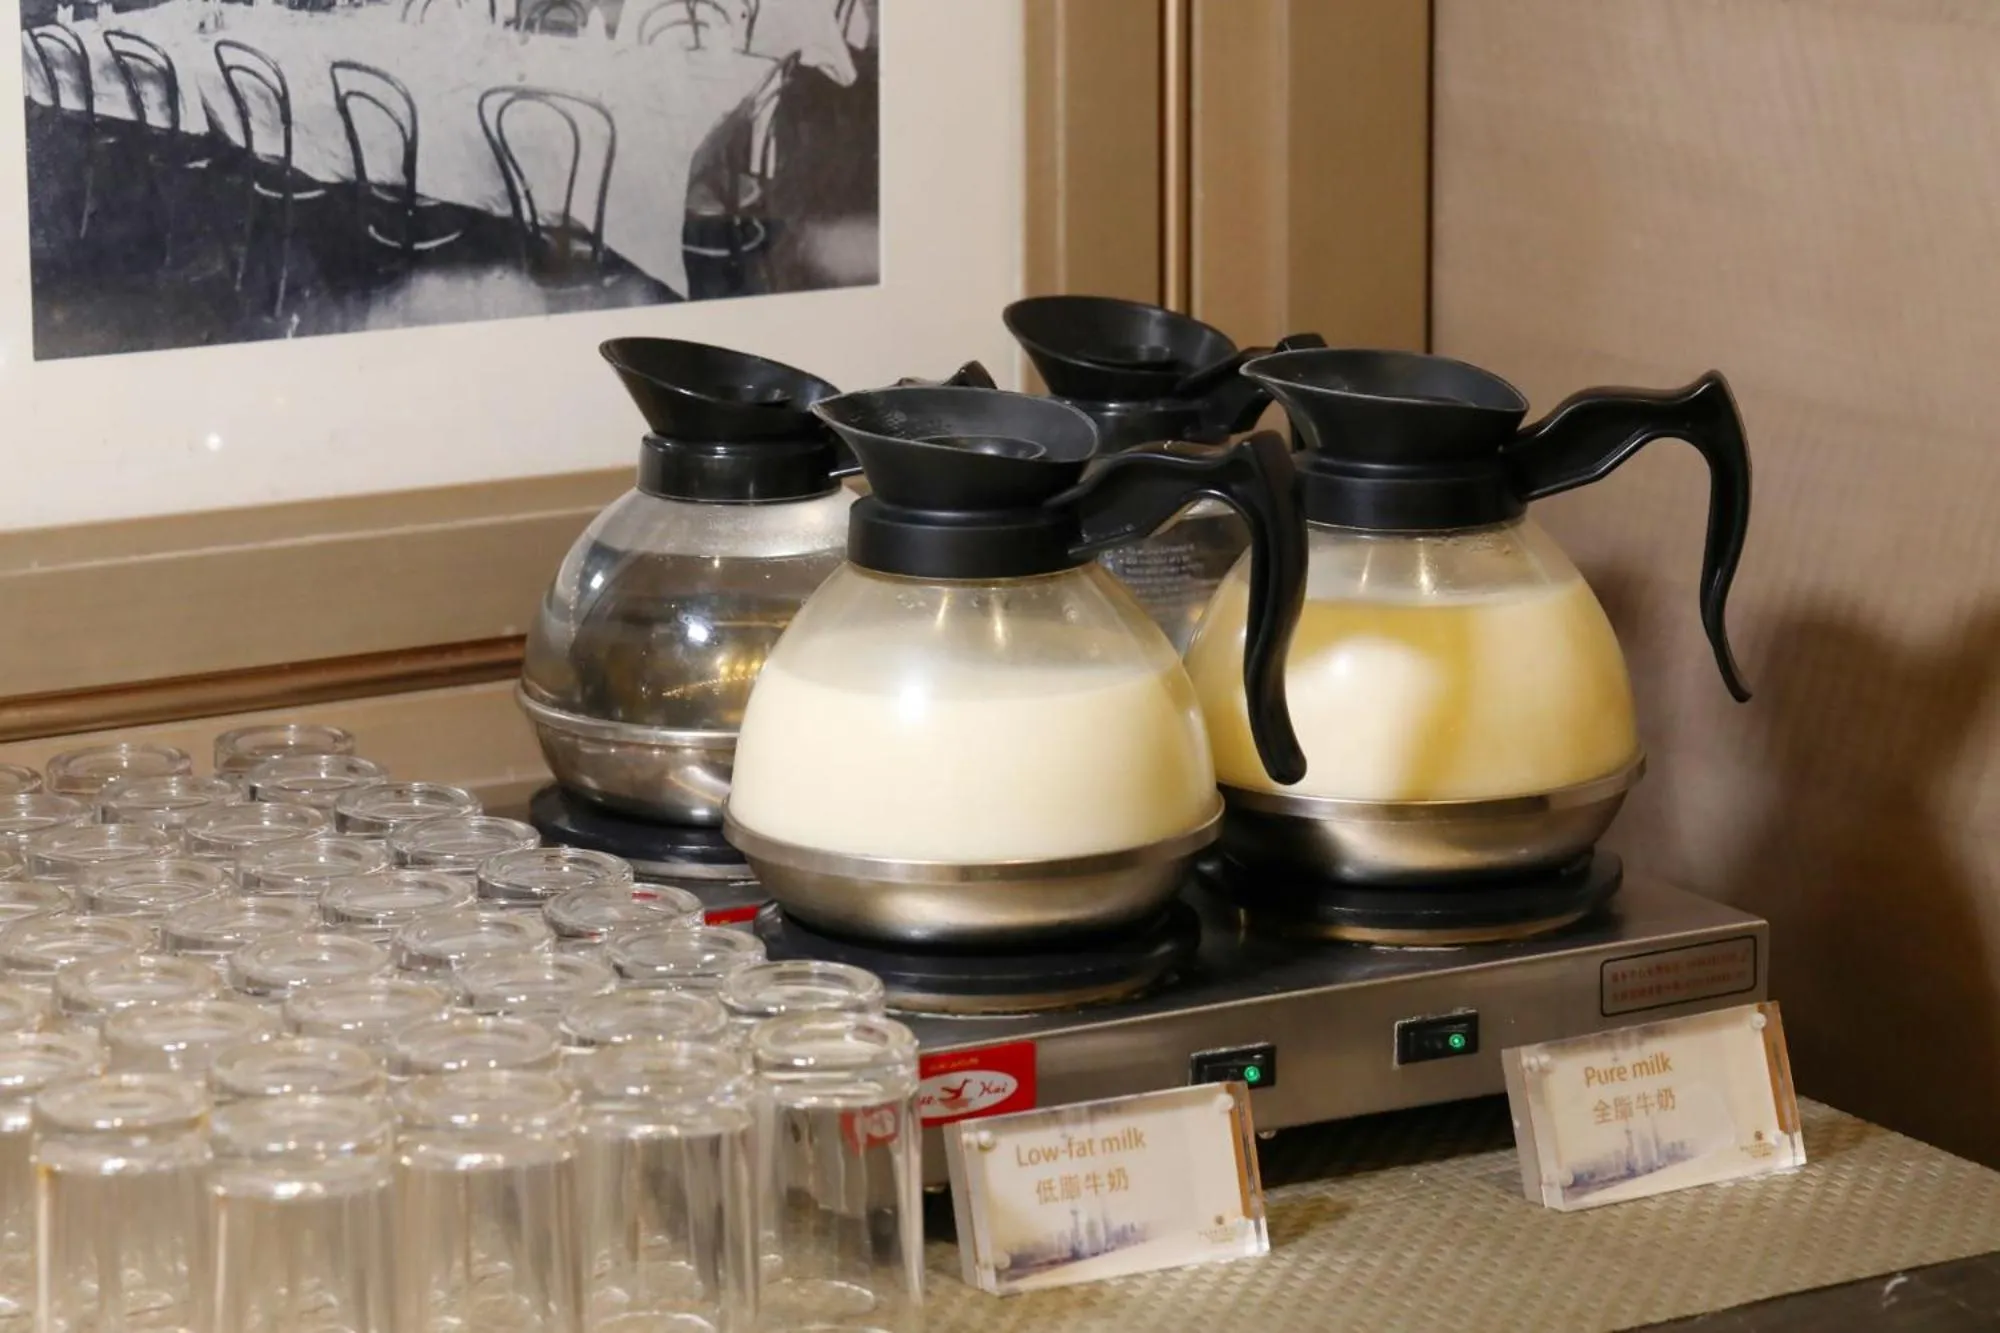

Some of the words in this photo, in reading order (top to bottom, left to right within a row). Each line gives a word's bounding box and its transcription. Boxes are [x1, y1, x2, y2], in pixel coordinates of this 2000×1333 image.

[1584, 1065, 1628, 1089] Pure
[1632, 1051, 1673, 1079] milk
[1592, 1085, 1676, 1125] 全脂牛奶
[1015, 1135, 1096, 1168] Low-fat
[1101, 1125, 1147, 1154] milk
[1035, 1166, 1130, 1205] 低脂牛奶
